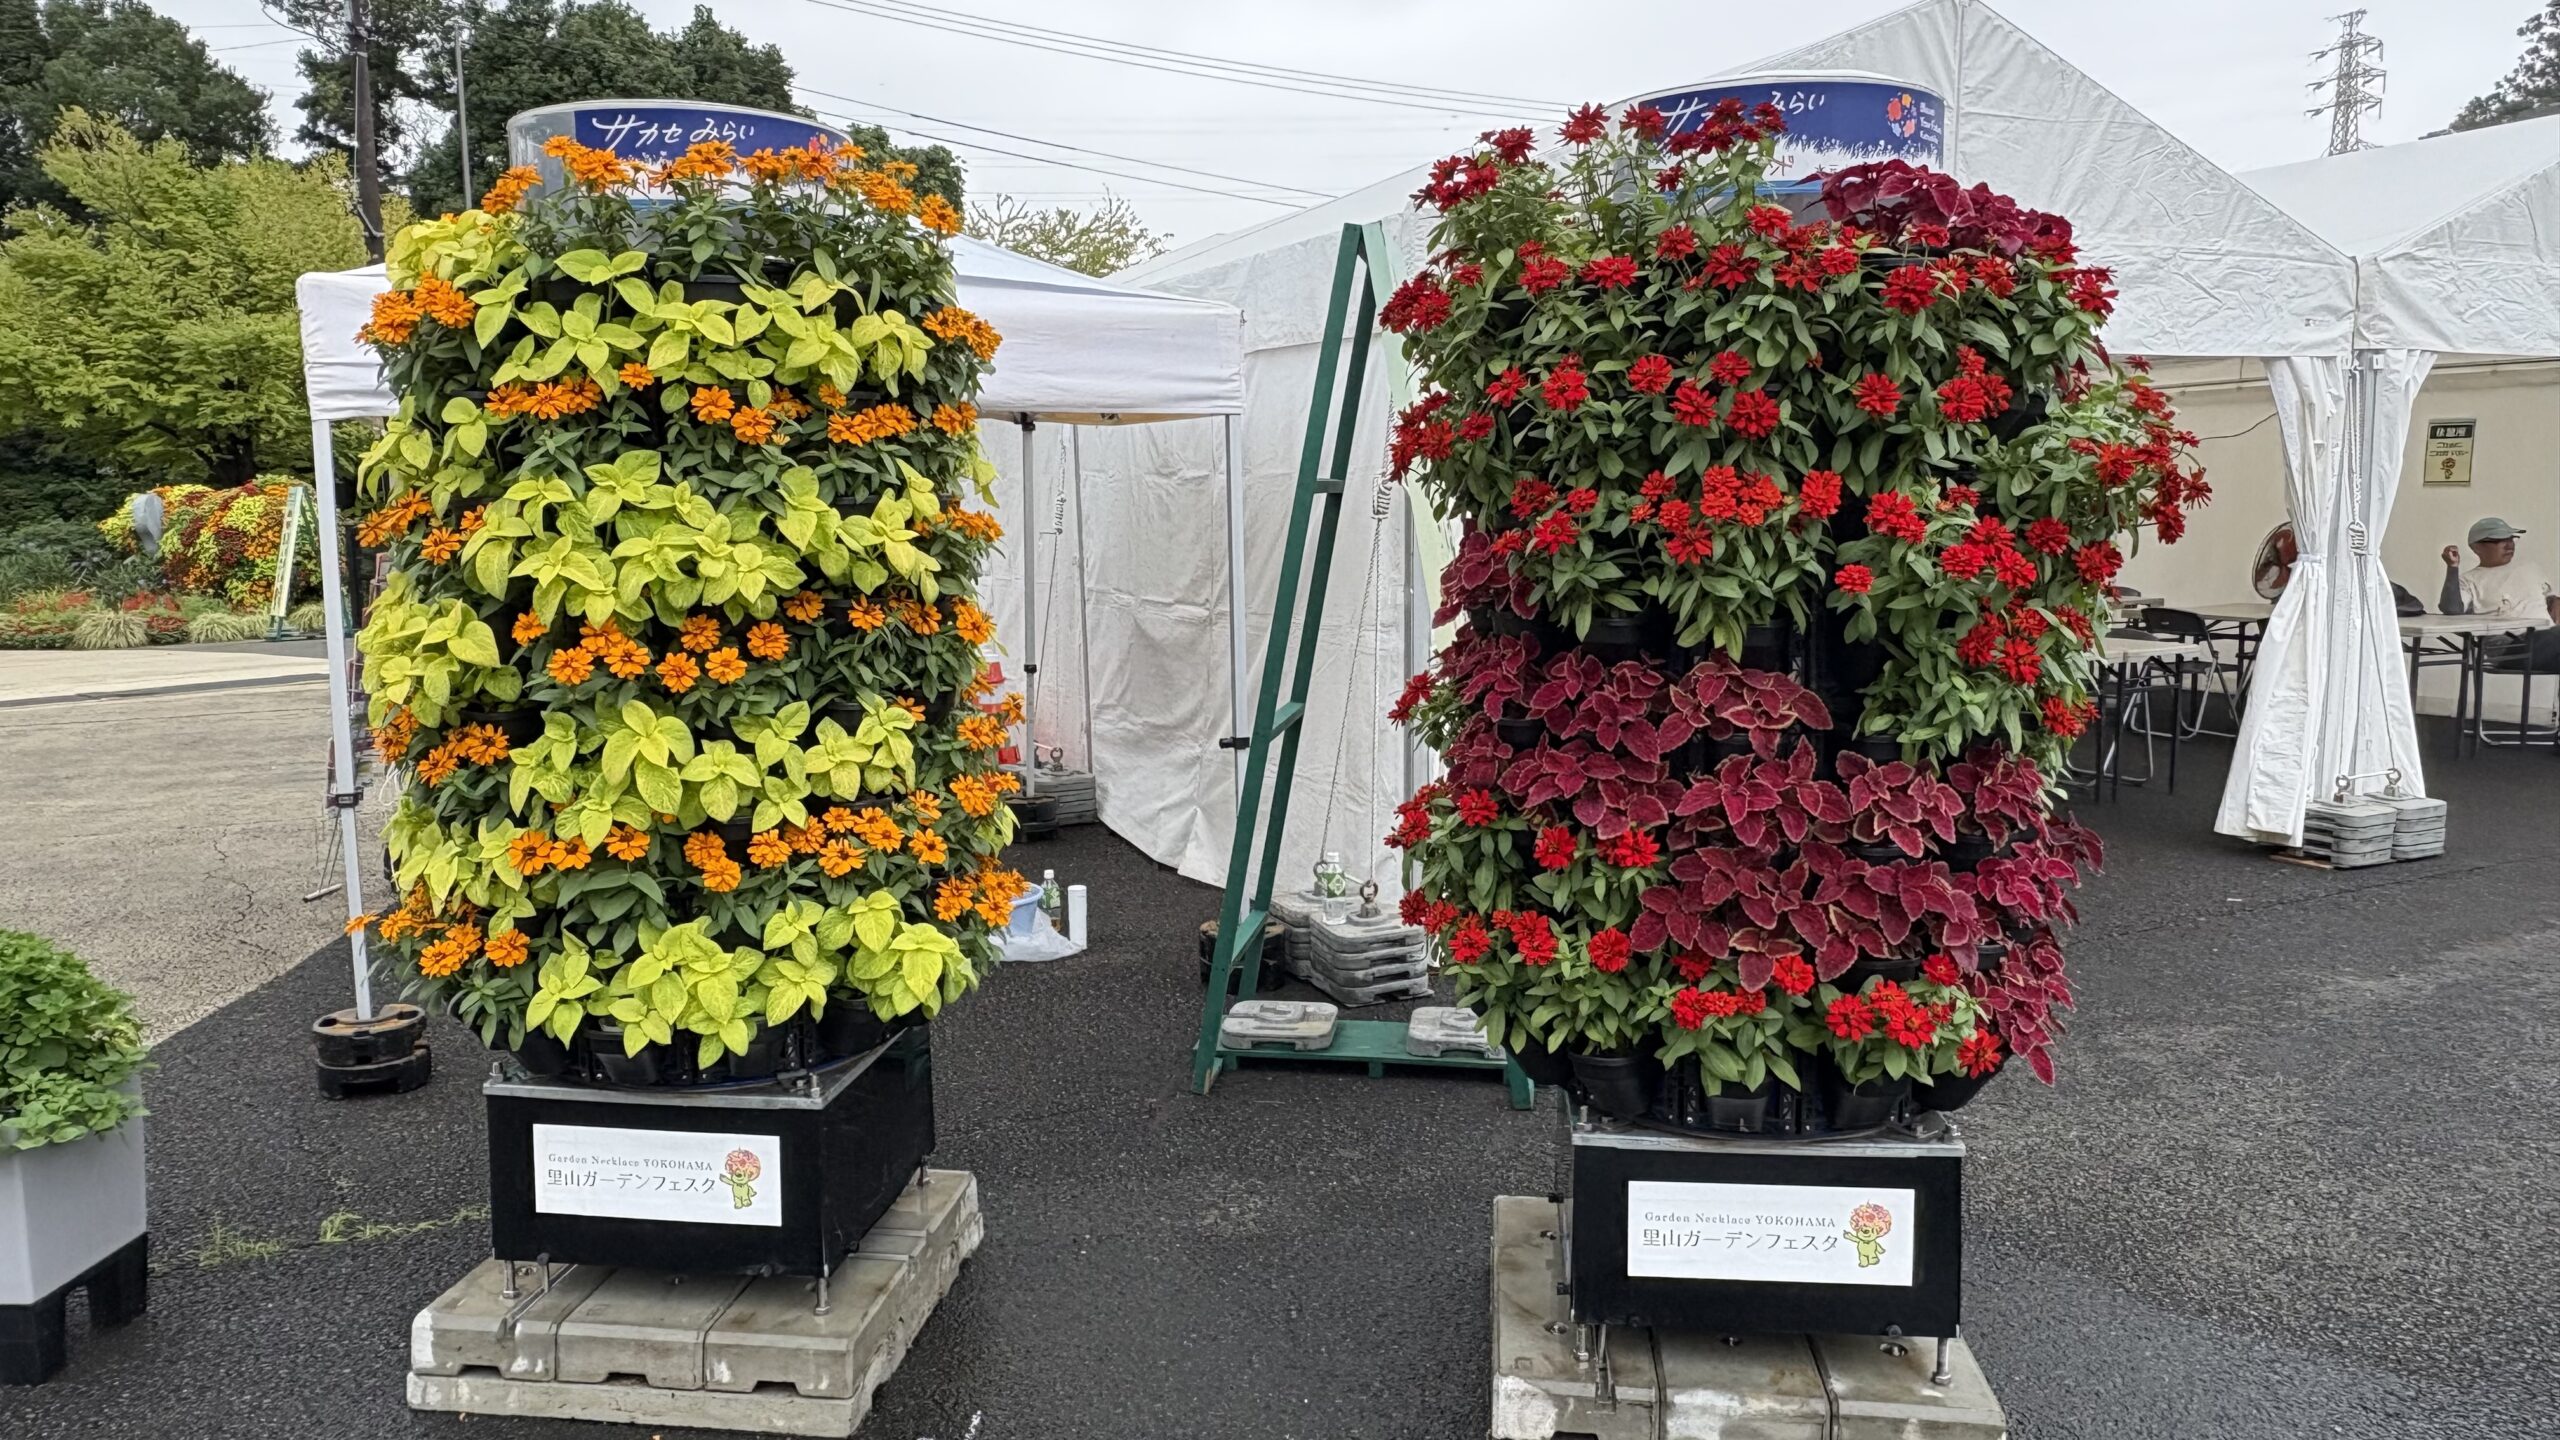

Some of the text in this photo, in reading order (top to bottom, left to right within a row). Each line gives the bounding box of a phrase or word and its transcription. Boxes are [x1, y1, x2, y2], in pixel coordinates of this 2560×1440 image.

[689, 117, 754, 143] みらい
[548, 1153, 713, 1170] Garden Necklace YOKOHAMA
[547, 1169, 715, 1193] 里山ガーデンフェスタ
[1645, 1211, 1836, 1228] Garden Necklace YOKOHAMA
[1643, 1228, 1838, 1251] 里山ガーデンフェスタ
